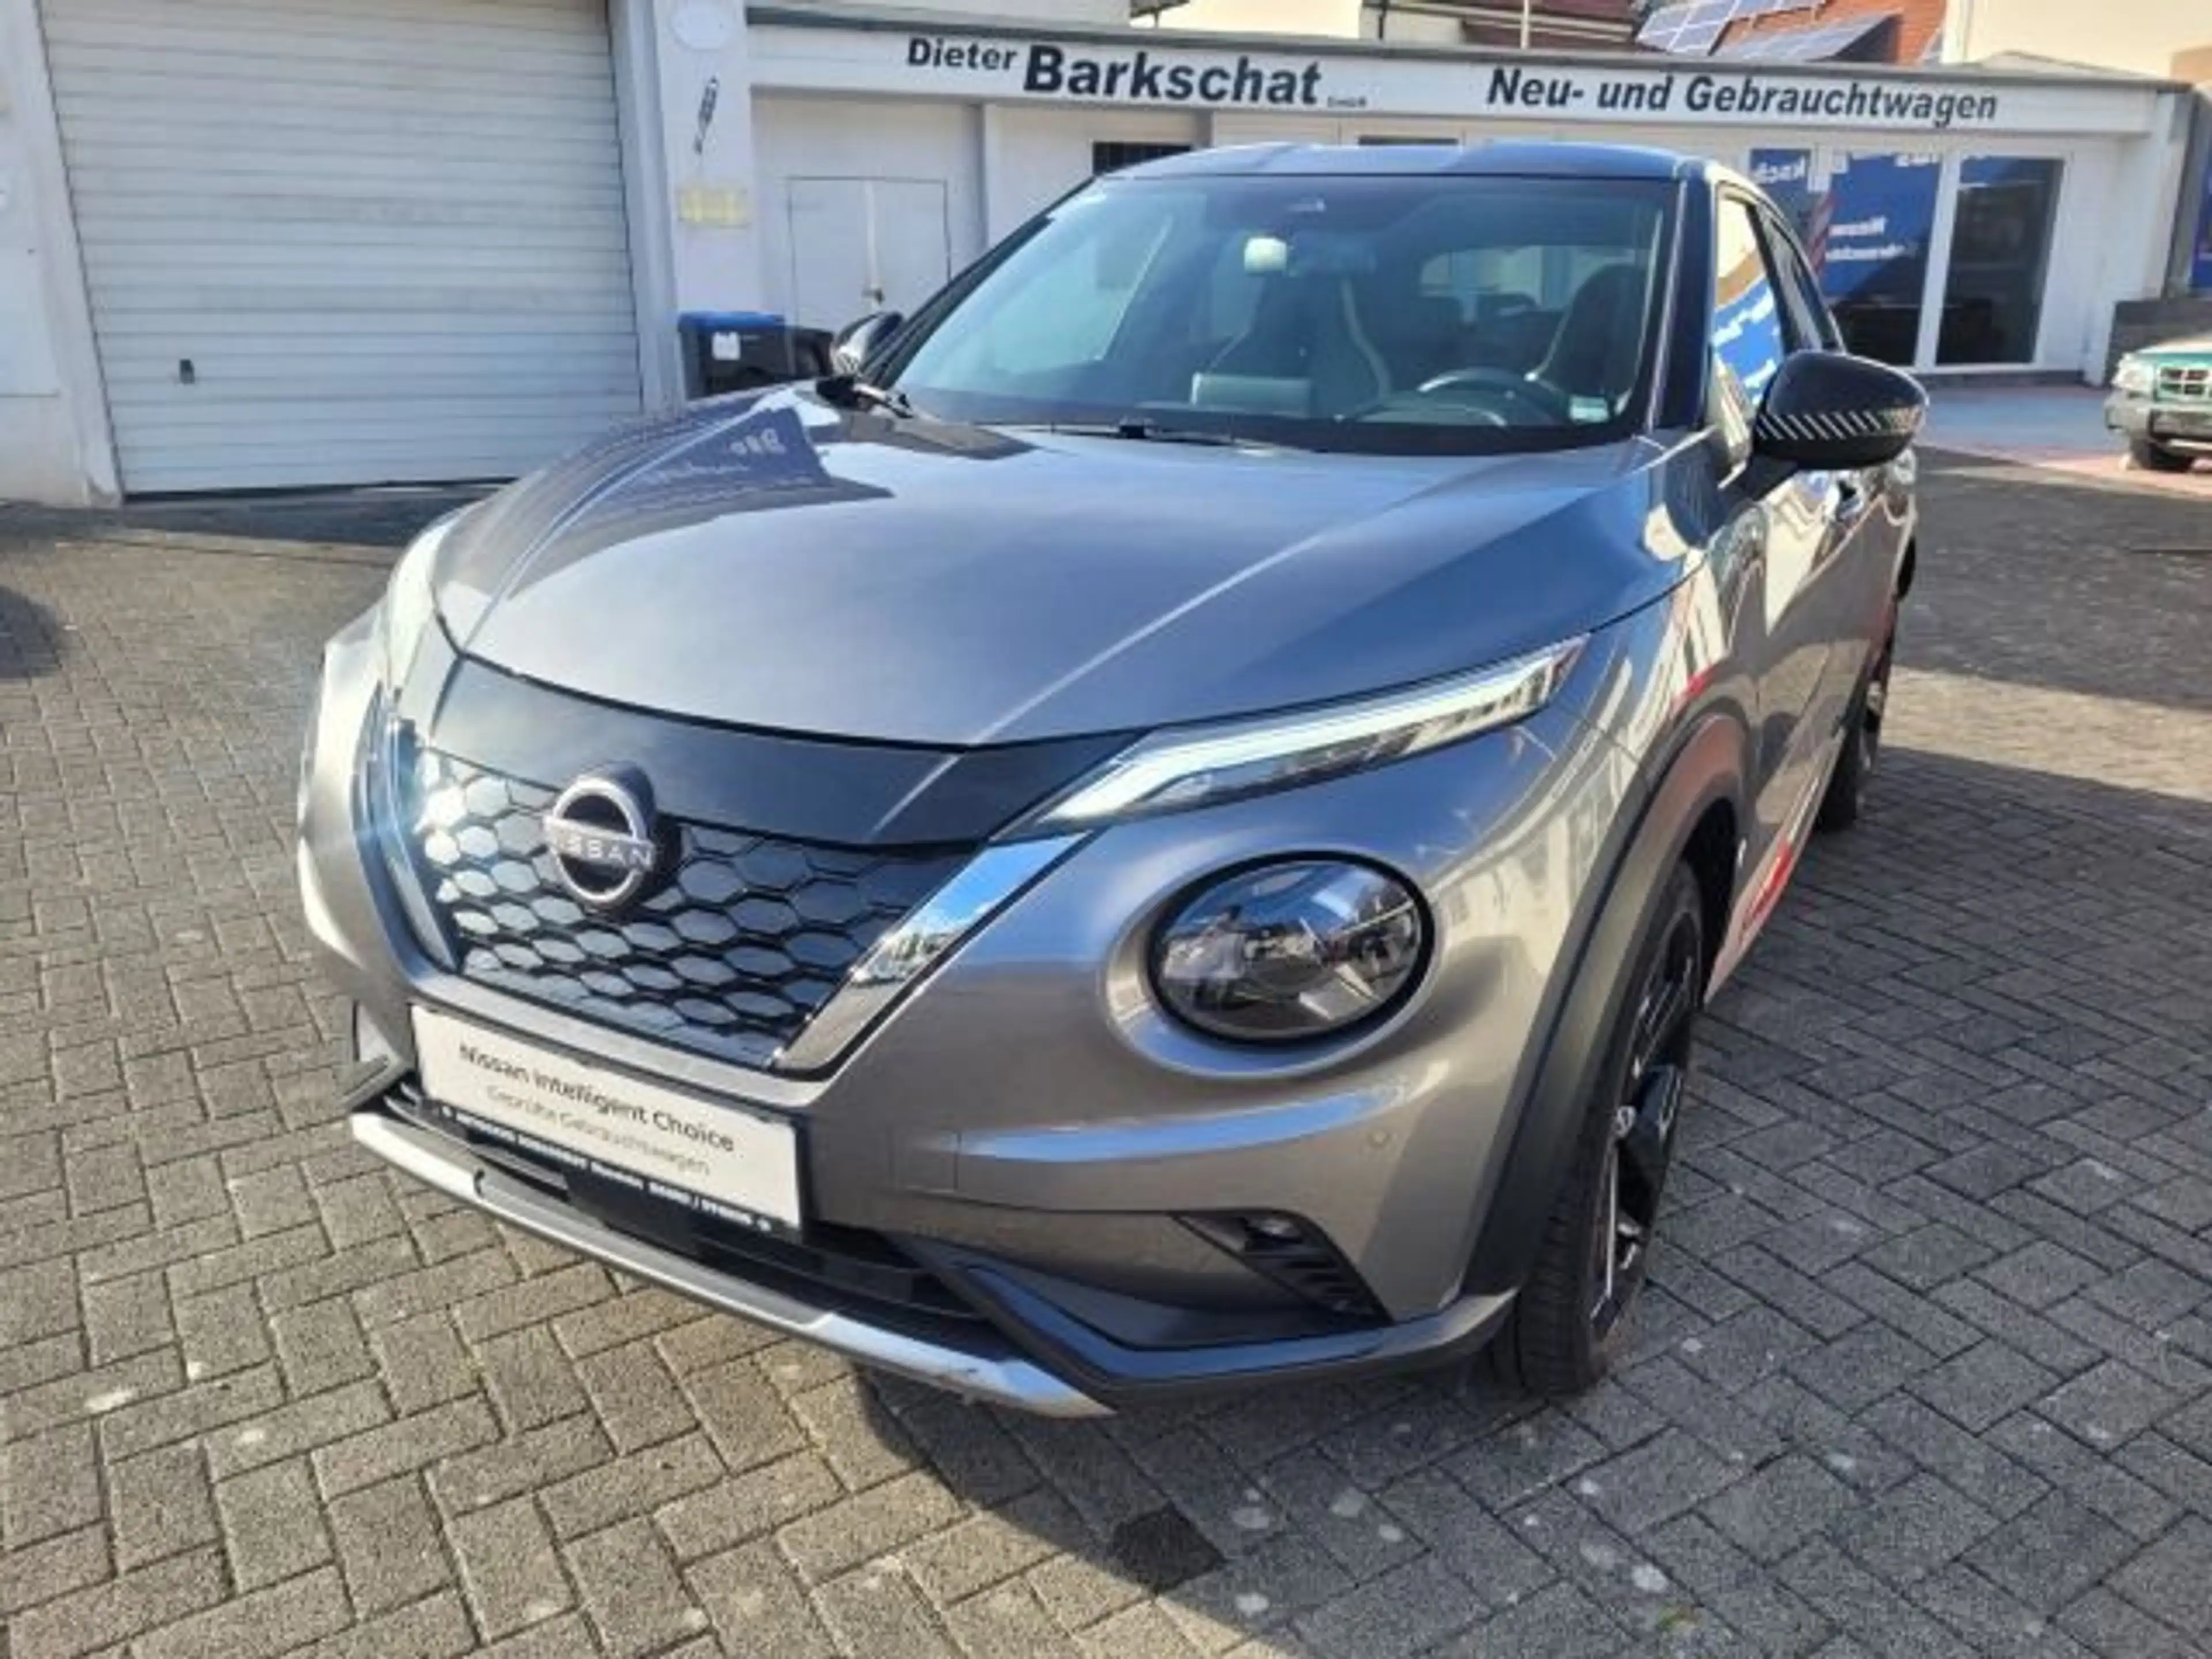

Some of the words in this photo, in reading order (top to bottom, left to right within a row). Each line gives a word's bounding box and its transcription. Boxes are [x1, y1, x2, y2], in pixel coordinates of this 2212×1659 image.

[907, 37, 1018, 71] Dieter
[1023, 44, 1323, 105] Barkschat
[1486, 67, 1584, 107] Neu-
[1597, 73, 1674, 111] und
[1685, 75, 1997, 128] Gebrauchtwagen
[460, 1041, 530, 1084] Nissan
[653, 1109, 734, 1152] Choice
